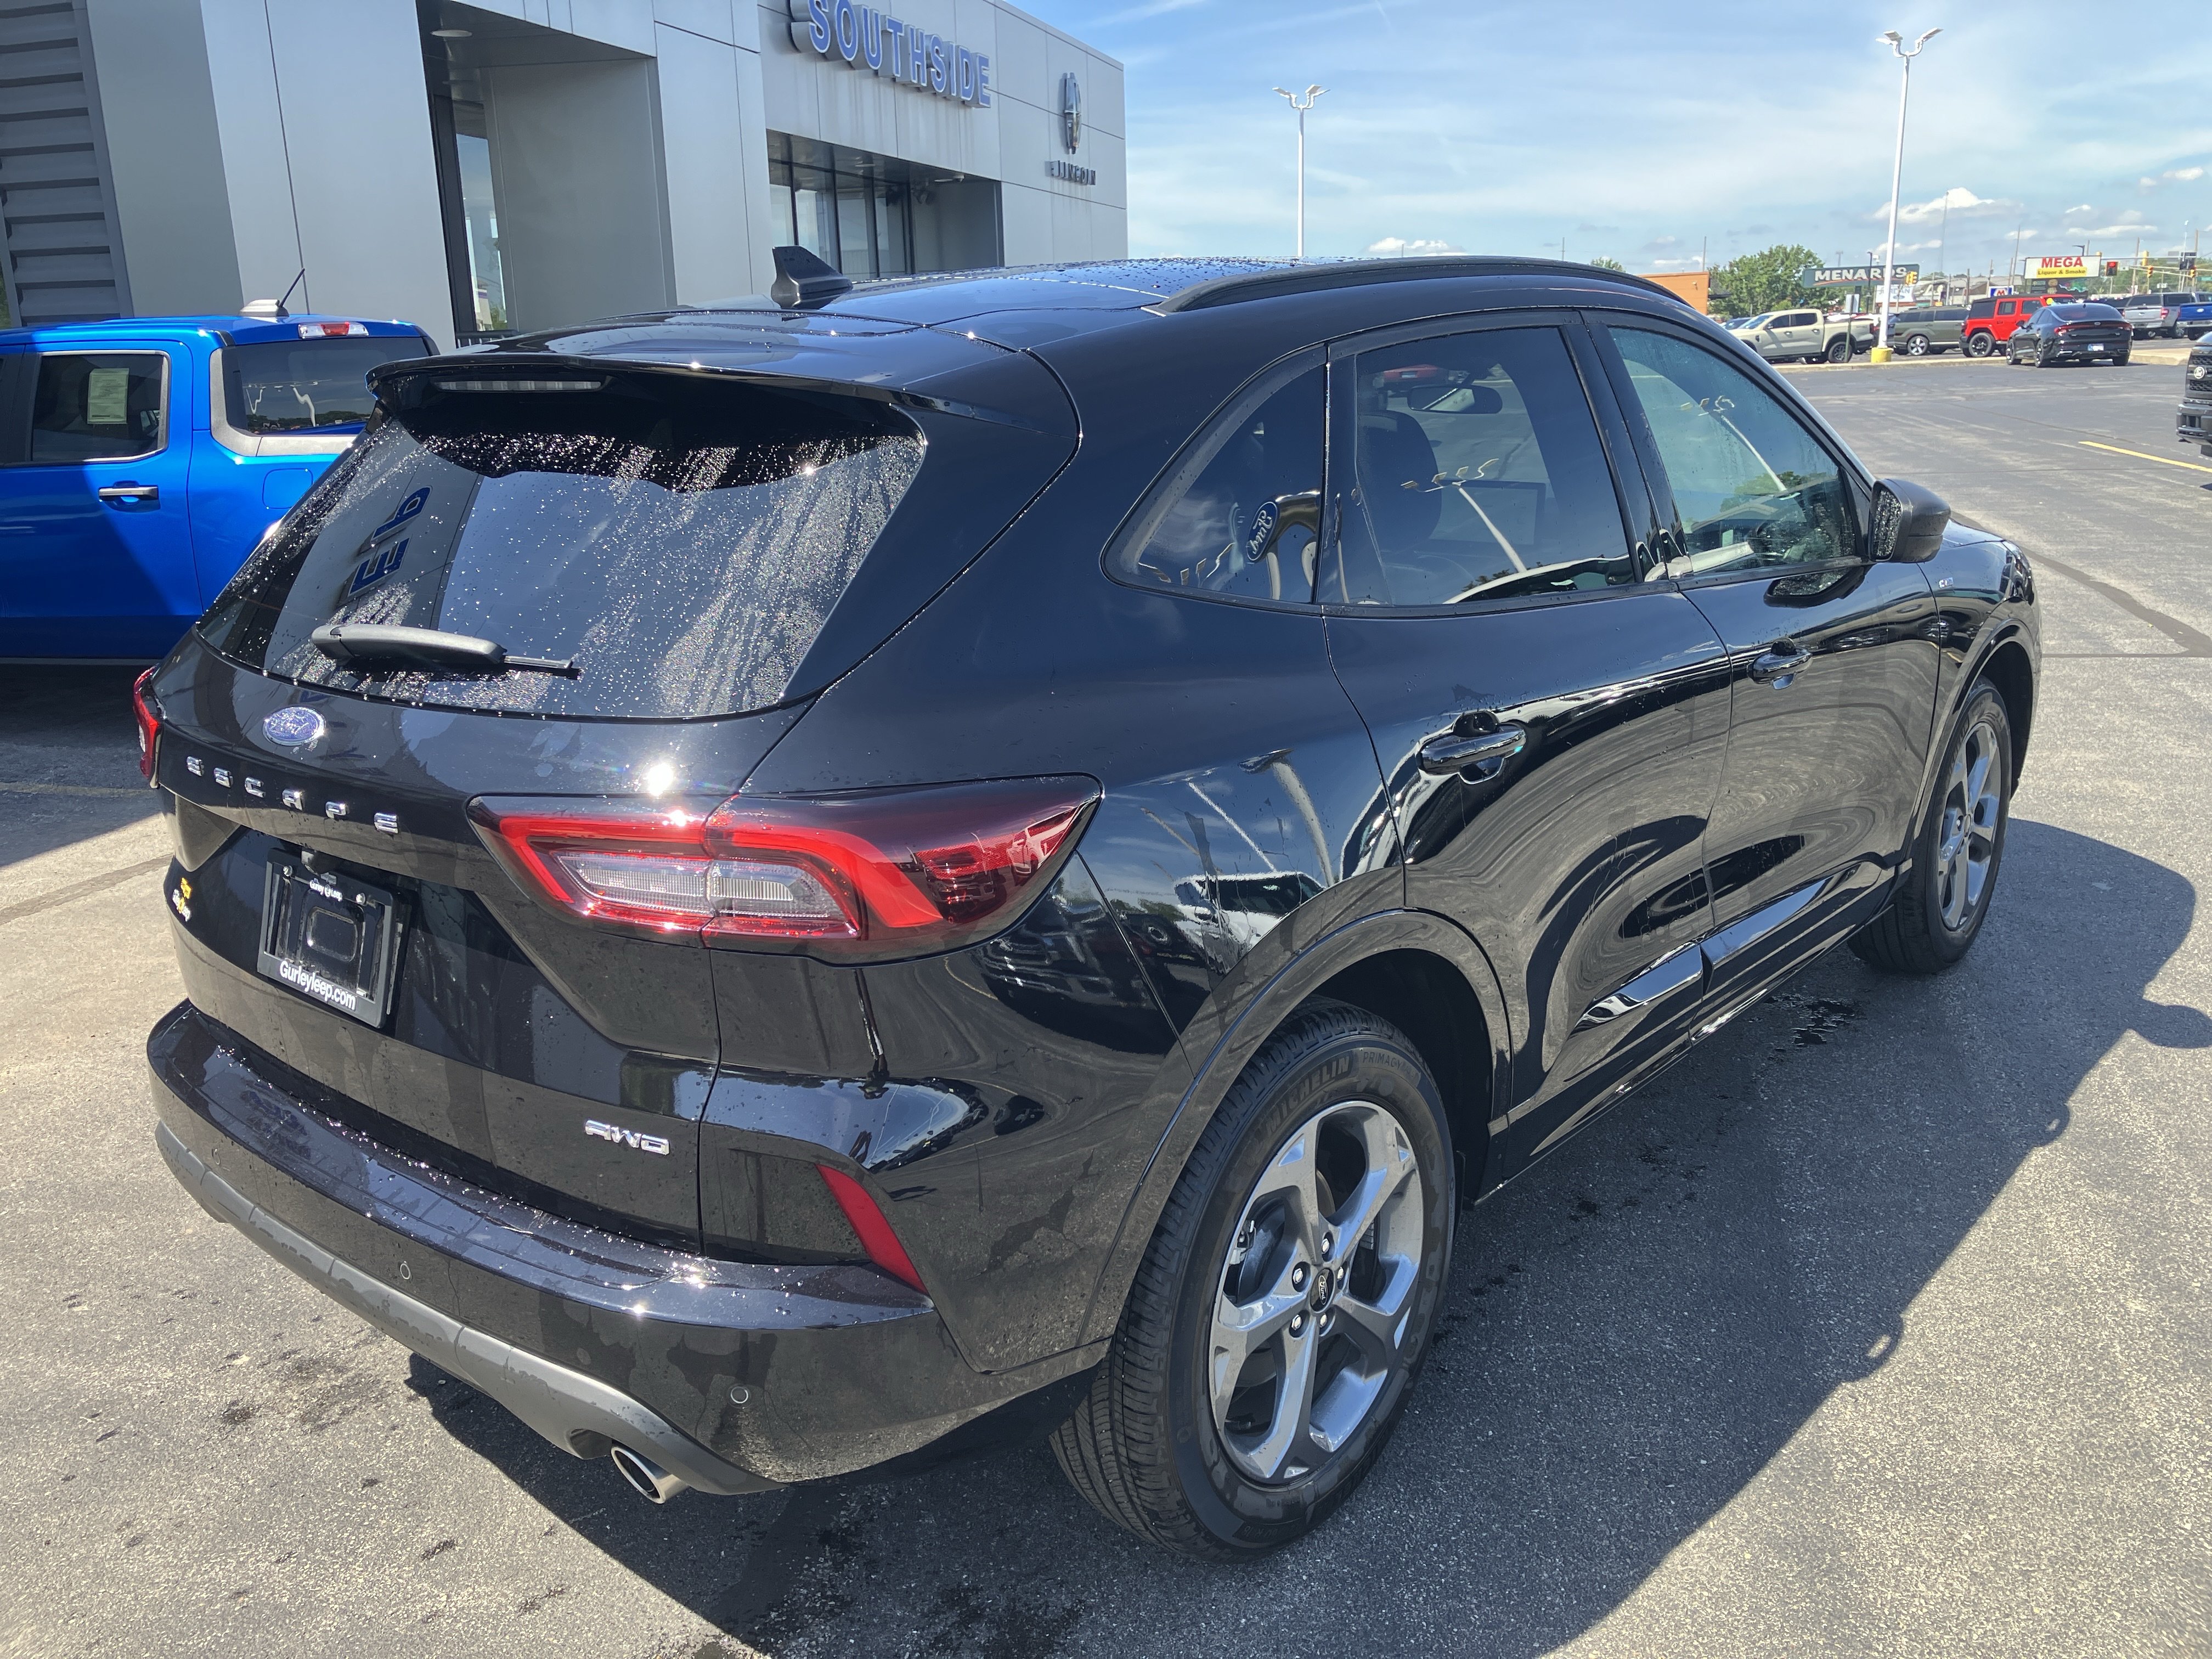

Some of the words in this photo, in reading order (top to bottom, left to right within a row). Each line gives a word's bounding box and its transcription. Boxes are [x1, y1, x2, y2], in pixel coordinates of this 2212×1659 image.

[808, 0, 991, 108] SOUTHSIDE
[2041, 256, 2084, 268] MEGA
[187, 756, 399, 834] ESCAPE
[1265, 1056, 1350, 1137] MICHELIN
[1363, 1051, 1402, 1070] PRIMACY
[584, 1119, 670, 1155] AWD
